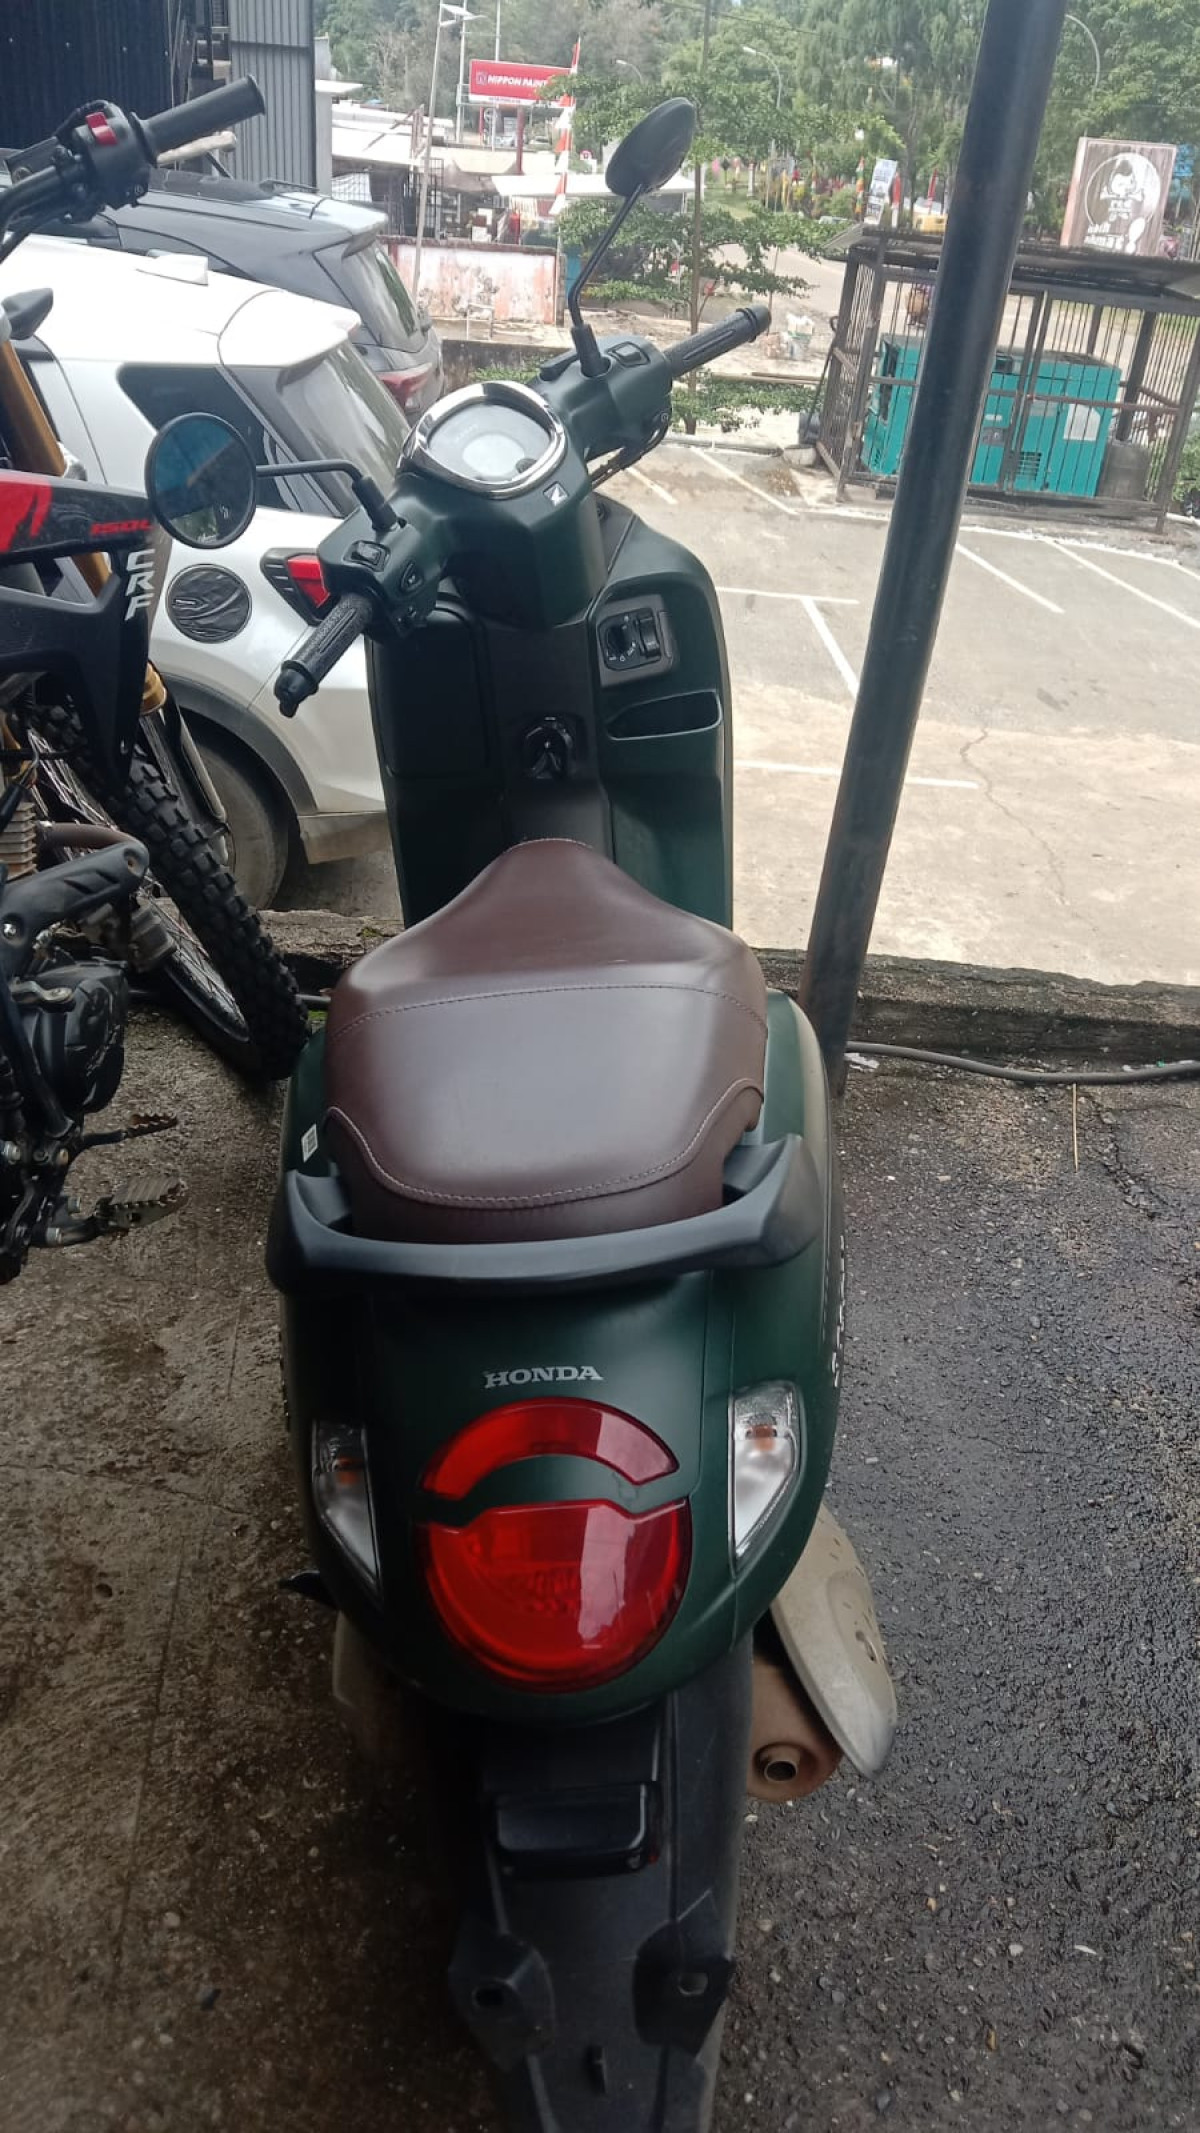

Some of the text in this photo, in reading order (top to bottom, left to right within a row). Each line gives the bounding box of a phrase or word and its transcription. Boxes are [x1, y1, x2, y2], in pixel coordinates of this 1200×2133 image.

[487, 74, 522, 86] NIPPON
[124, 549, 156, 621] CRF
[484, 1365, 604, 1389] HONDA
